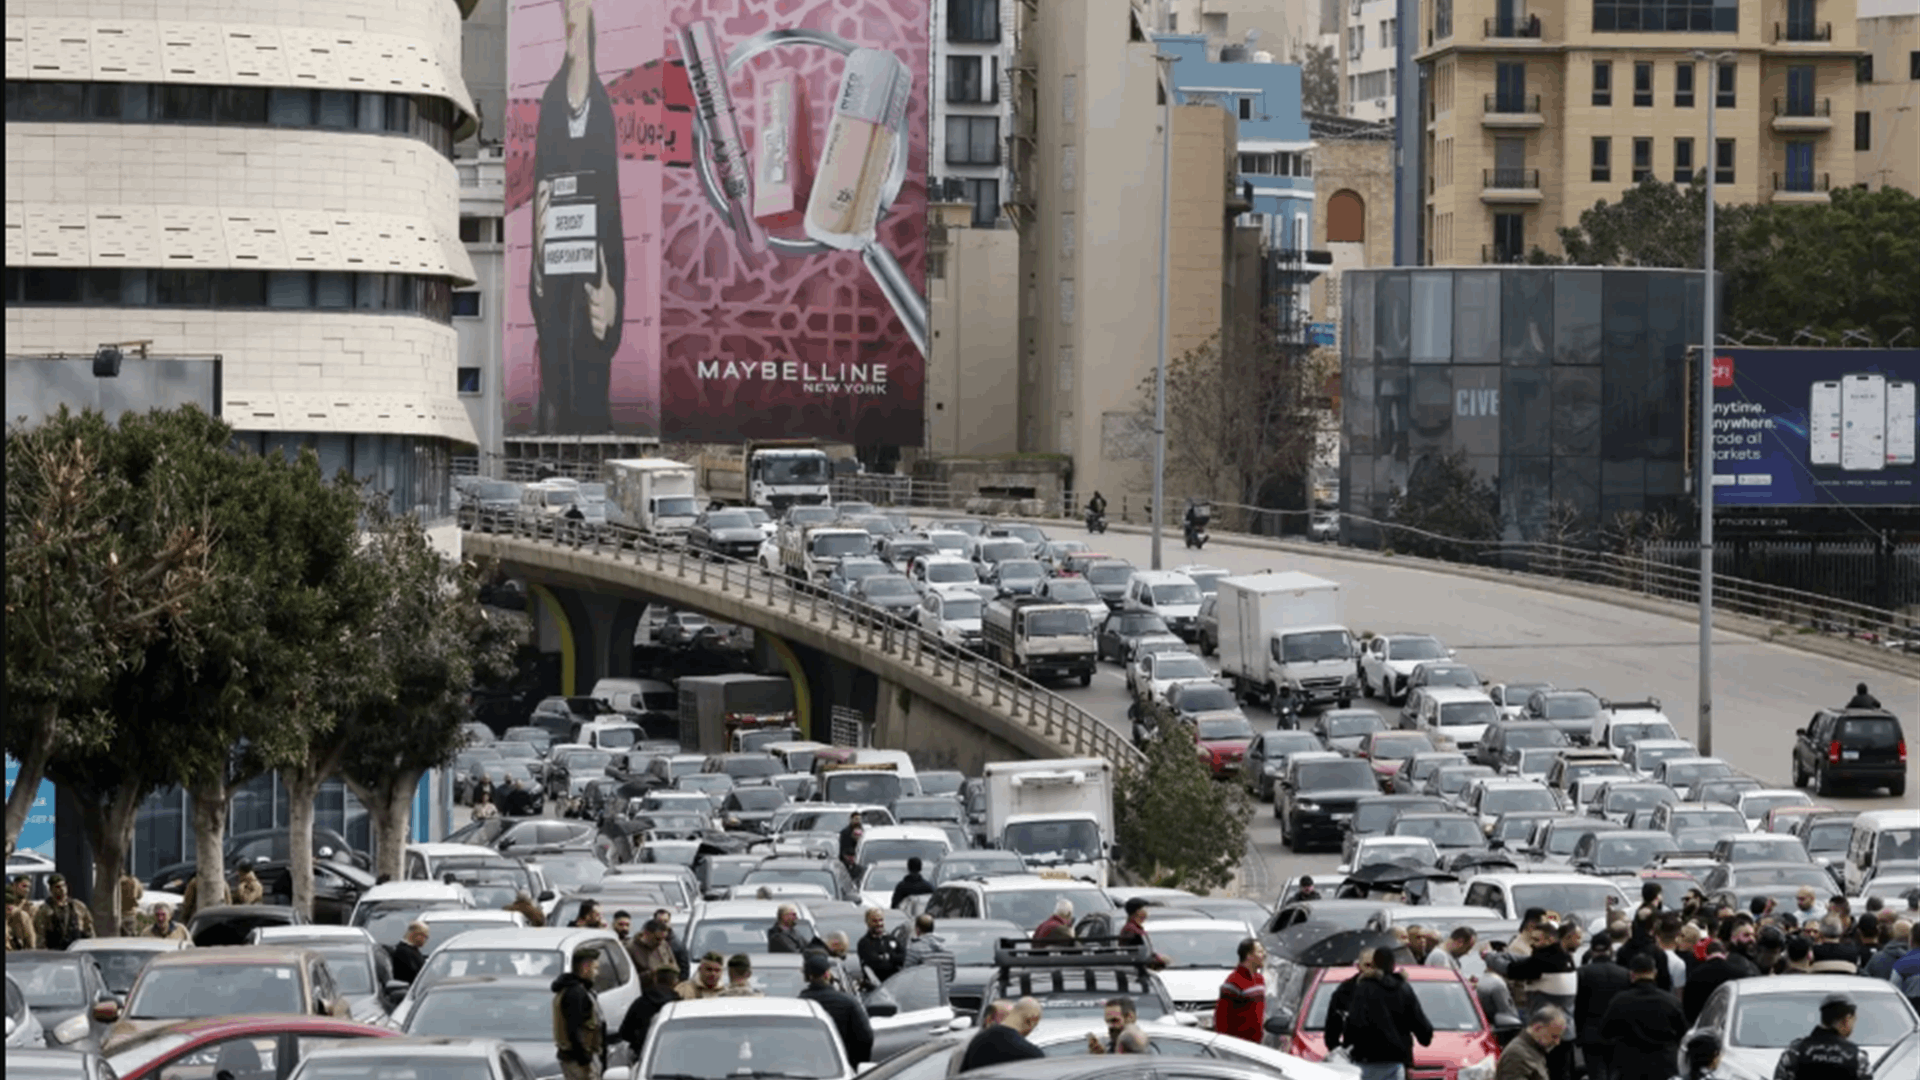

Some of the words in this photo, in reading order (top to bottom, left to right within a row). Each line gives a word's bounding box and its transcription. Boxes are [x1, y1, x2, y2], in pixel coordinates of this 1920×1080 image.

[697, 360, 888, 383] MAYBELLINE
[803, 382, 841, 393] NEW
[844, 383, 887, 395] YORK
[1711, 400, 1766, 416] nytime.
[1711, 416, 1777, 432] nywhere.
[1712, 431, 1744, 445] rade
